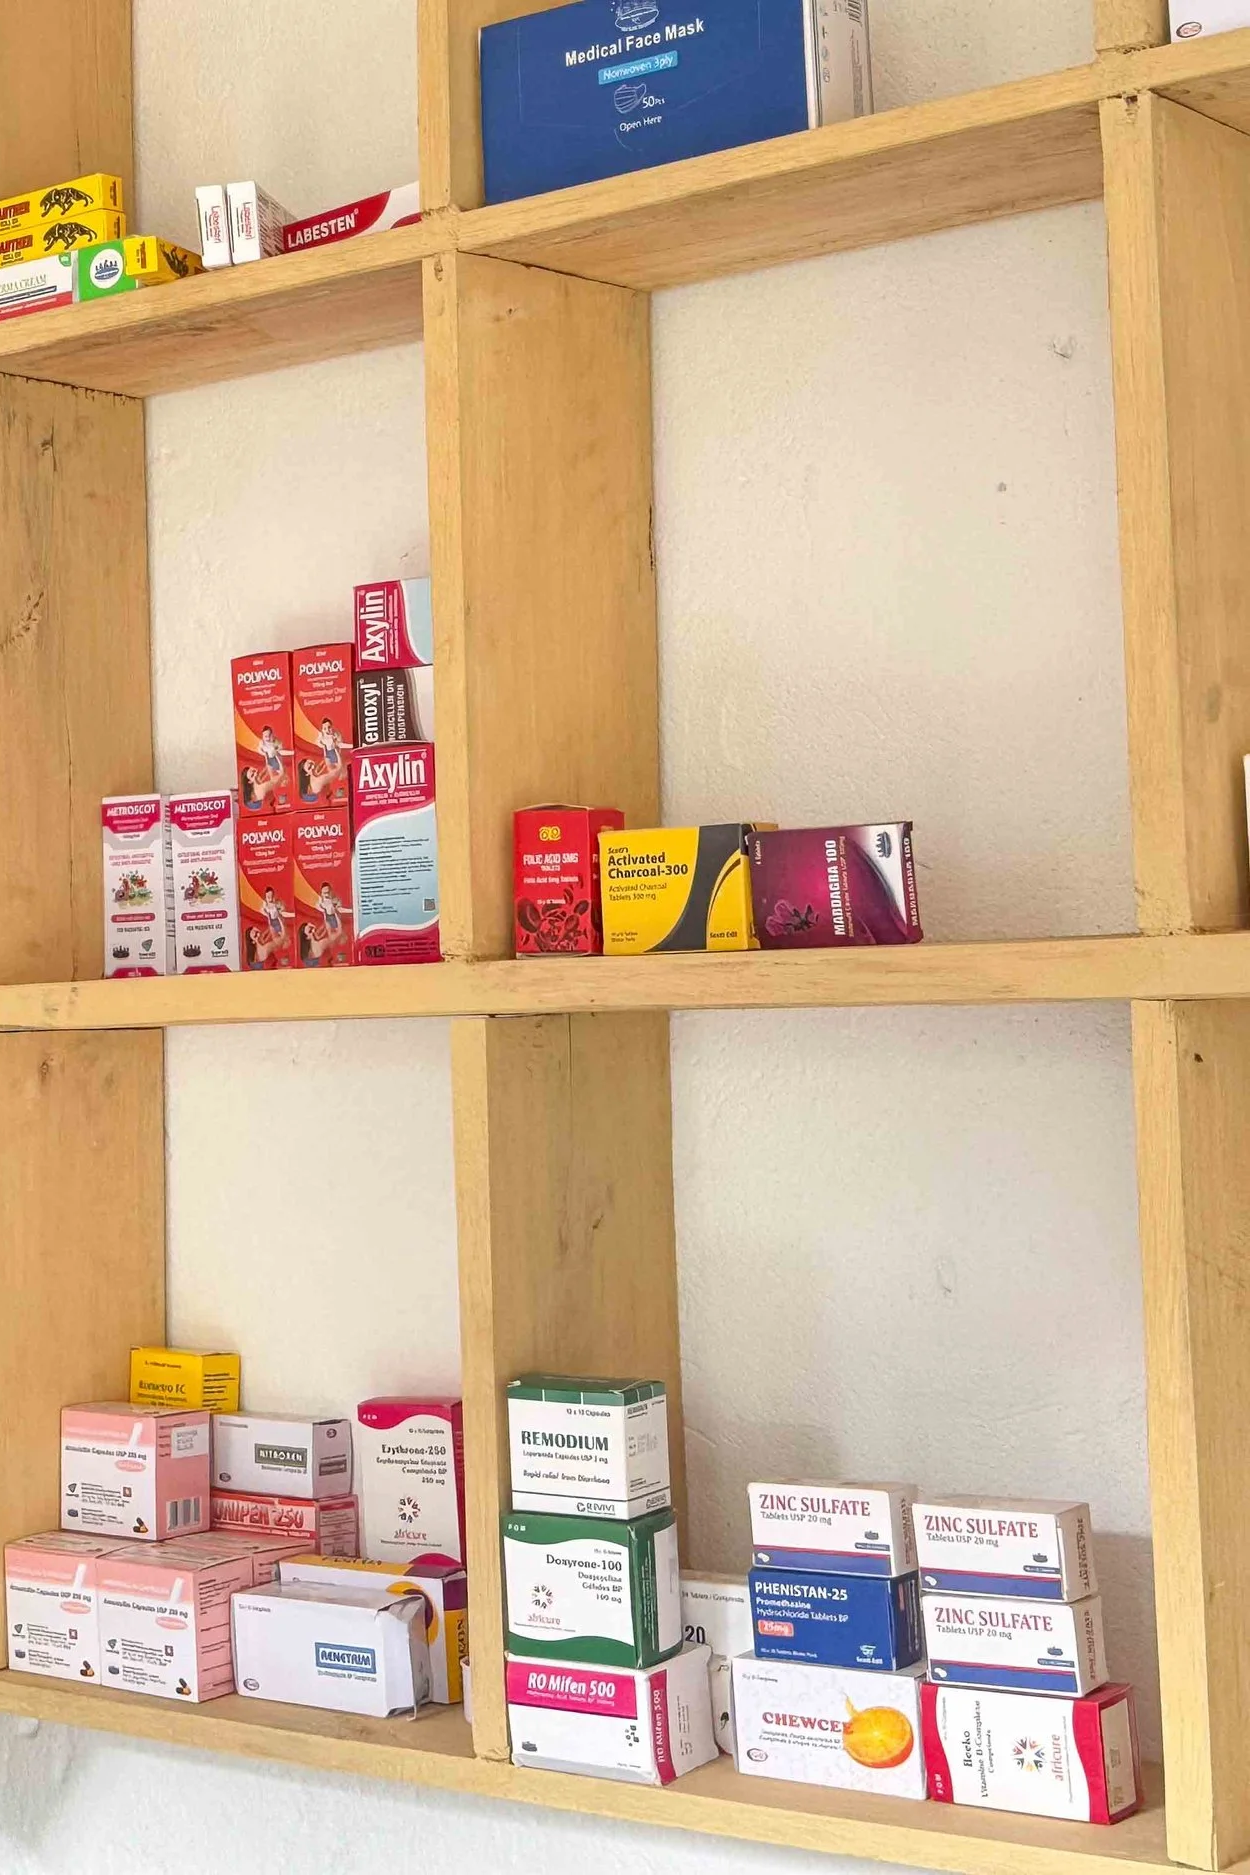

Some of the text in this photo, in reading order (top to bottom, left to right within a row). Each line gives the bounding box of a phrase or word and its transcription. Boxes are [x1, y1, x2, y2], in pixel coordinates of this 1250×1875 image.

[565, 18, 705, 67] Medical Face Mask
[619, 115, 662, 132] Open Here
[287, 213, 356, 248] LABESTEN
[360, 591, 389, 663] Axylin
[237, 668, 282, 685] POLYMOL
[299, 660, 345, 676] POLYMOL
[359, 754, 425, 793] Axylin
[107, 804, 155, 817] METROSCOT
[174, 800, 226, 814] METROSCOT
[242, 829, 286, 844] POLYMOL
[297, 824, 343, 839] POLYMOL
[607, 852, 666, 867] Activated
[825, 840, 837, 863] 100
[607, 864, 688, 879] Charcoal-300
[521, 1431, 609, 1451] REMODIUM
[759, 1494, 871, 1517] ZINC SULFATE
[761, 1511, 832, 1525] Tablets USP 20 mg
[924, 1515, 1038, 1538] ZINC SULFATE
[926, 1533, 999, 1547] Tablets USP 20 mg
[546, 1554, 622, 1571] Doxyrone-100
[755, 1582, 848, 1601] PHENISTAN-25
[811, 1610, 837, 1622] Tablets
[935, 1607, 1053, 1632] ZINC SULFATE
[685, 1626, 705, 1644] 20
[937, 1625, 1012, 1640] Tablets USP 20 mg
[528, 1672, 615, 1698] RO Mifen 500
